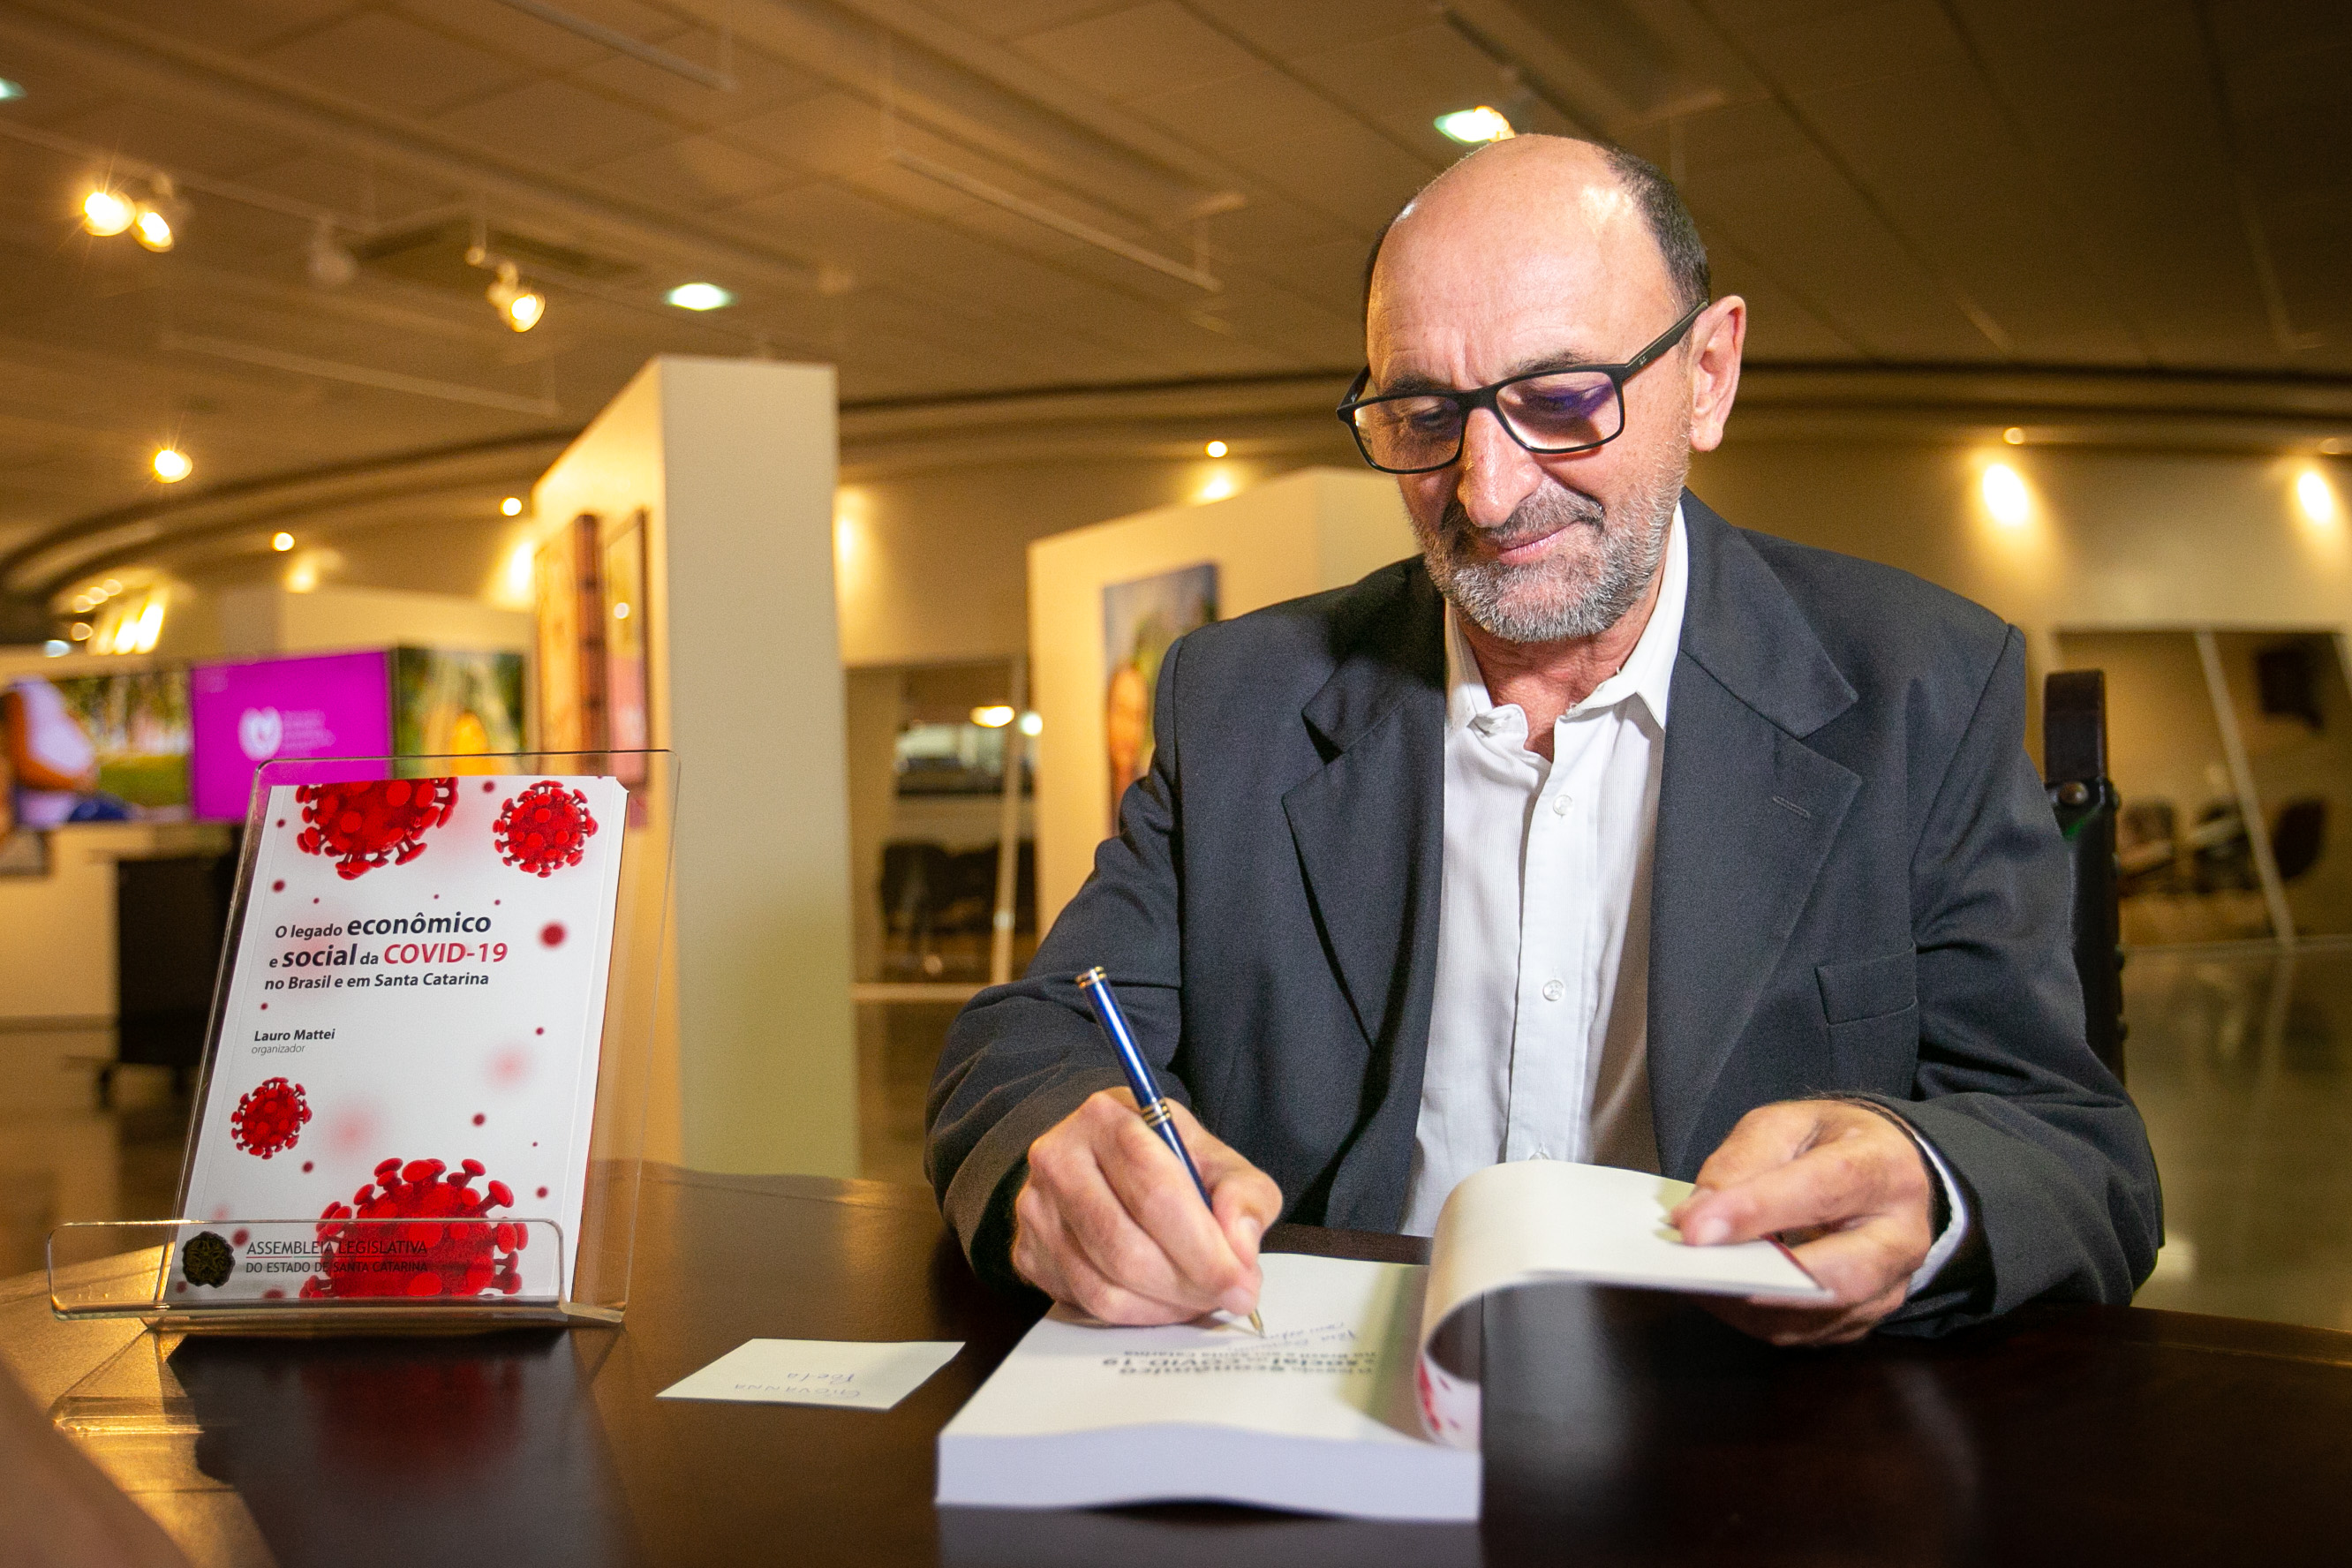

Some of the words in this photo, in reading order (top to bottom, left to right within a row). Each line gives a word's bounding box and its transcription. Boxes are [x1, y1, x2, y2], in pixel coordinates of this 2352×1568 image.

[275, 925, 288, 939] O
[290, 923, 343, 941] legado
[346, 911, 492, 936] econômico
[268, 957, 278, 969] e
[282, 943, 358, 968] social
[359, 952, 380, 966] da
[383, 942, 509, 965] COVID-19
[264, 979, 284, 991] no
[288, 975, 331, 990] Brasil
[334, 977, 343, 988] e
[346, 976, 371, 988] em
[373, 974, 418, 987] Santa
[423, 972, 489, 986] Catarina
[253, 1029, 290, 1042] Lauro
[293, 1028, 335, 1041] Mattei
[251, 1044, 305, 1056] organizador
[246, 1240, 334, 1255] ASSEMBLEIA
[338, 1240, 428, 1255] LEGISLATIVA
[245, 1262, 263, 1273] DO
[267, 1262, 310, 1273] ESTADO
[314, 1262, 329, 1273] DE
[333, 1262, 369, 1273] SANTA
[372, 1262, 428, 1273] CATARINA
